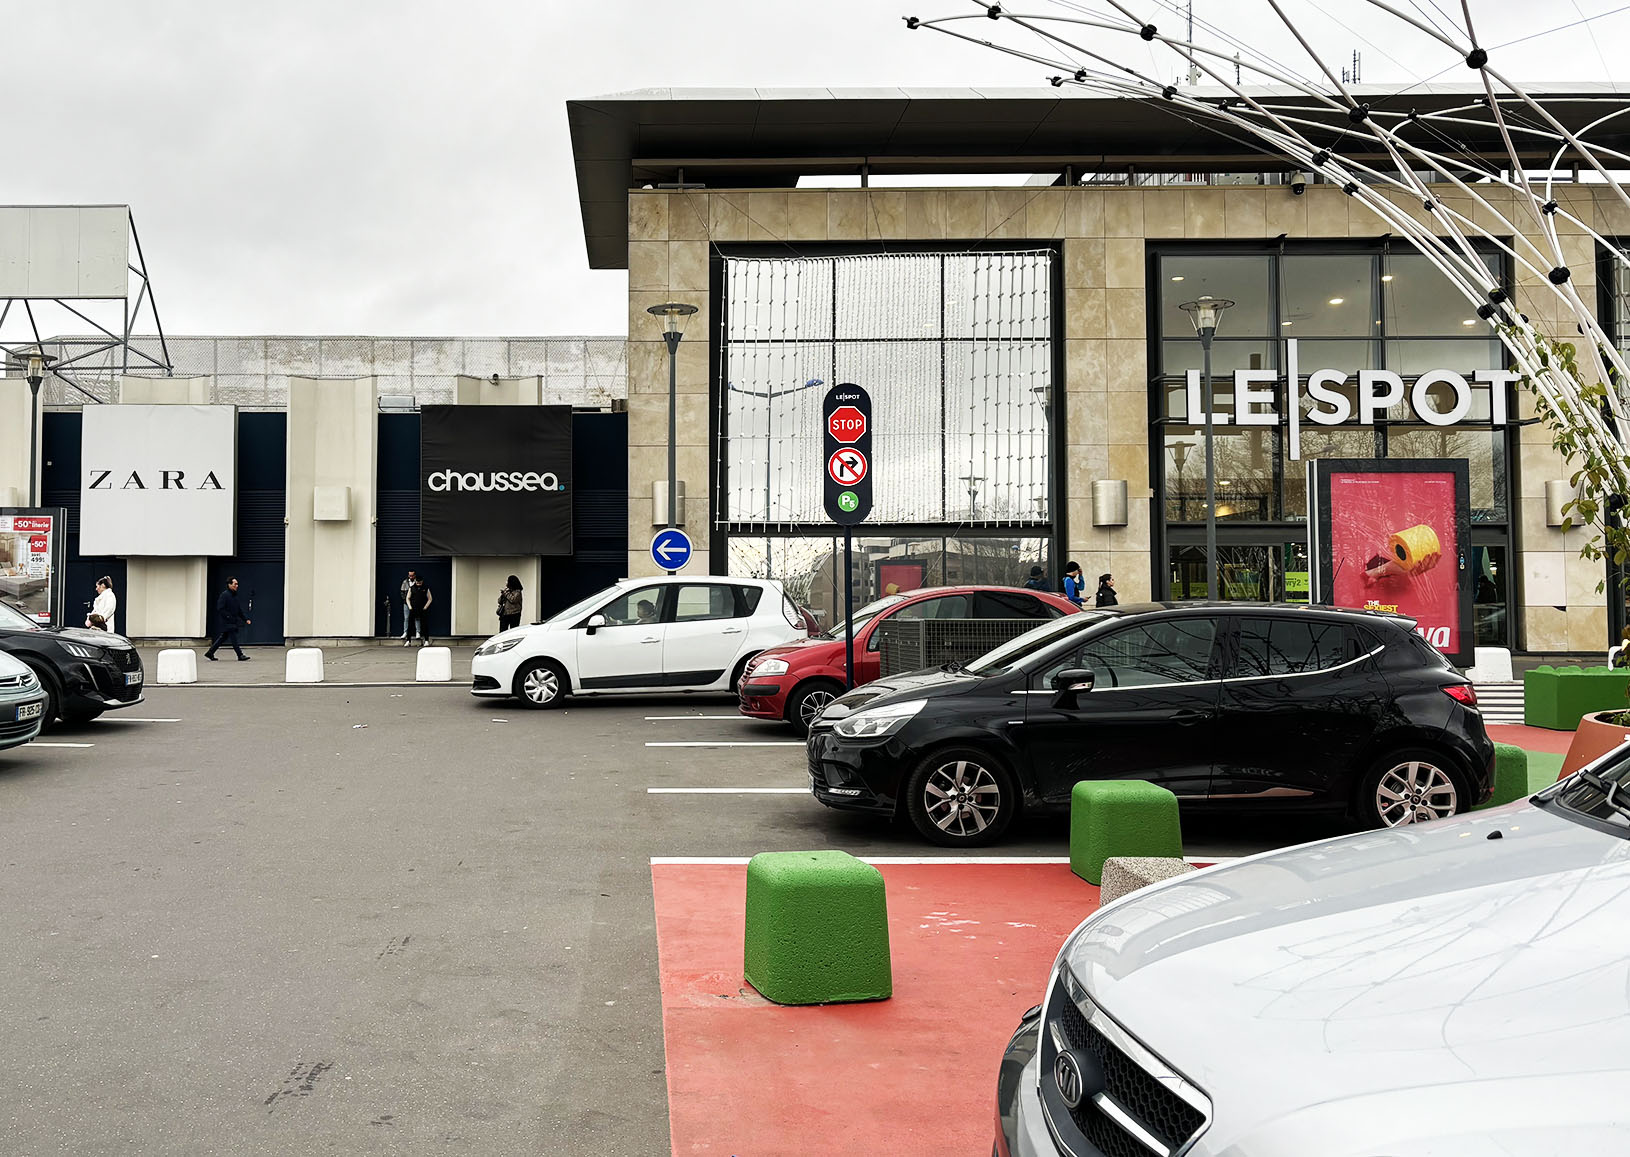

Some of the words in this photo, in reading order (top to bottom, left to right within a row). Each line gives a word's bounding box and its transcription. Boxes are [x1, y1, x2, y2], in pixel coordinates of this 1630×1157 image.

[832, 419, 863, 431] STOP
[88, 470, 226, 490] ZARA
[1363, 604, 1399, 613] SEXIEST
